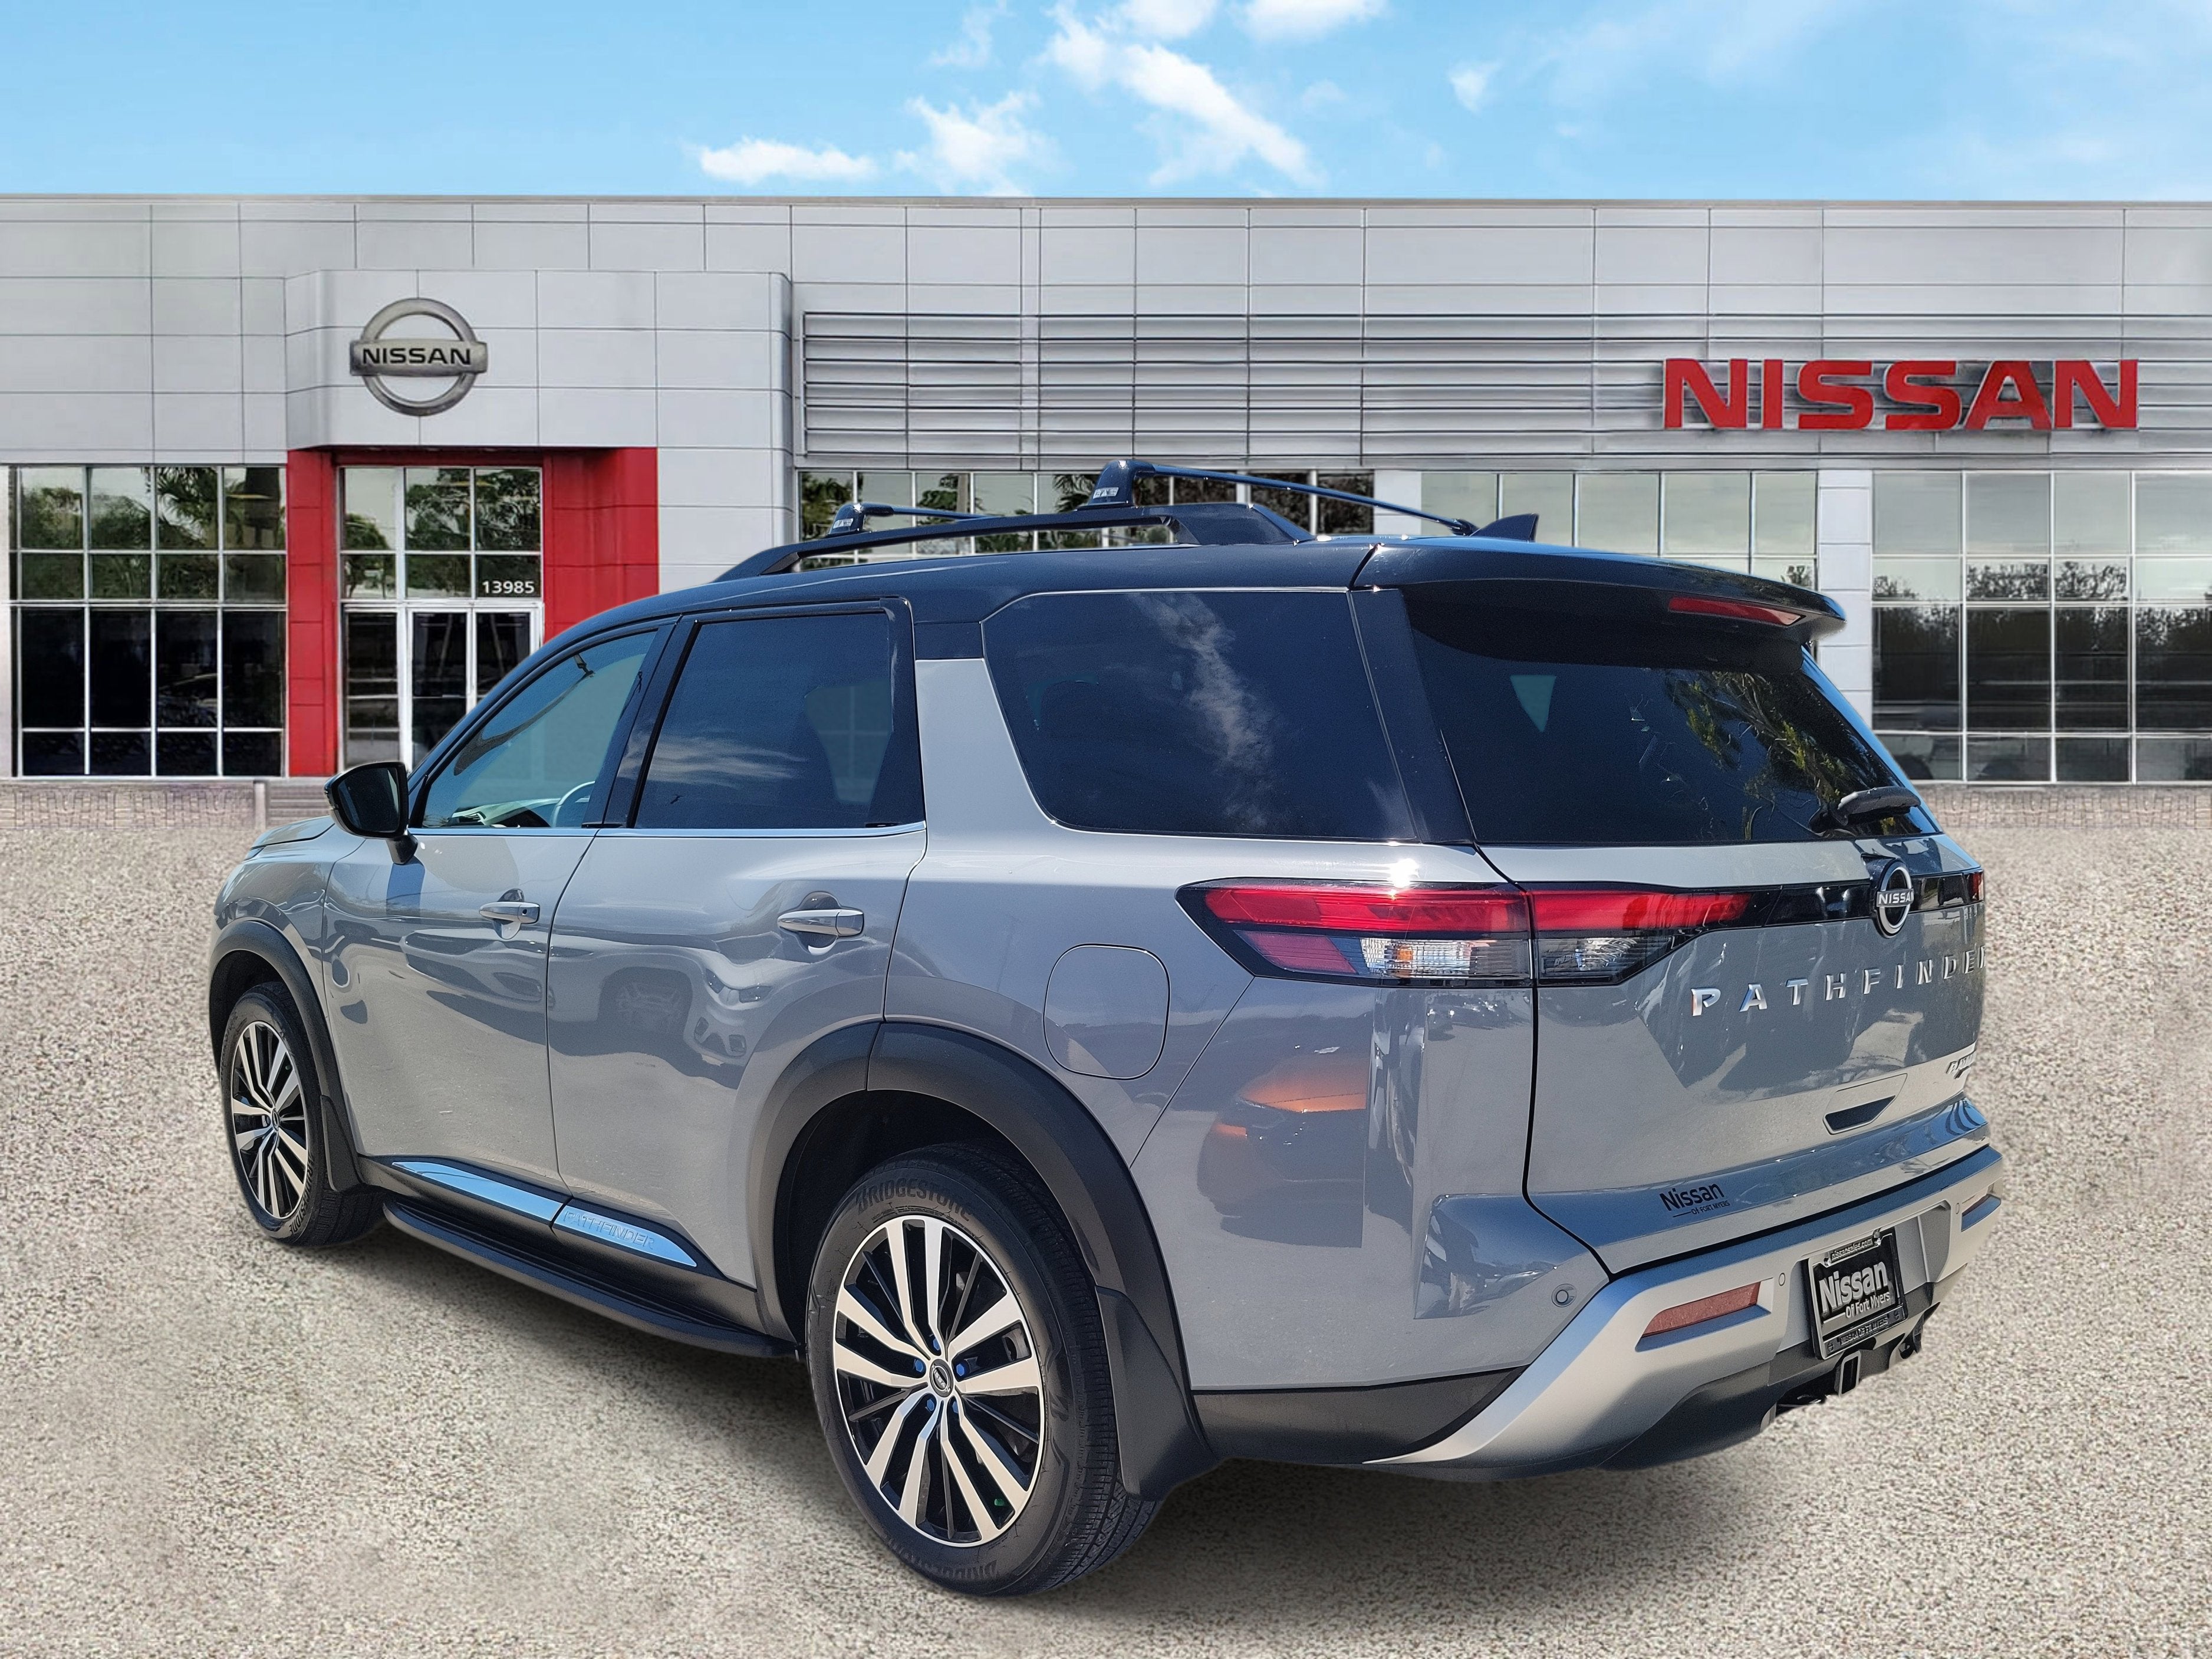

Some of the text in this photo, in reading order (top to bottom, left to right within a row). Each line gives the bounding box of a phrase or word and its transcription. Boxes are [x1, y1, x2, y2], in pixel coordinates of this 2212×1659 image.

[362, 347, 471, 366] NISSAN
[1663, 358, 2139, 431] NISSAN
[482, 580, 535, 594] 13985
[1659, 1183, 1725, 1212] Nissan
[563, 1210, 655, 1250] PATHFINDER
[1819, 1261, 1888, 1314] Nissan
[1855, 1298, 1871, 1315] Fort
[1870, 1291, 1891, 1309] Myers
